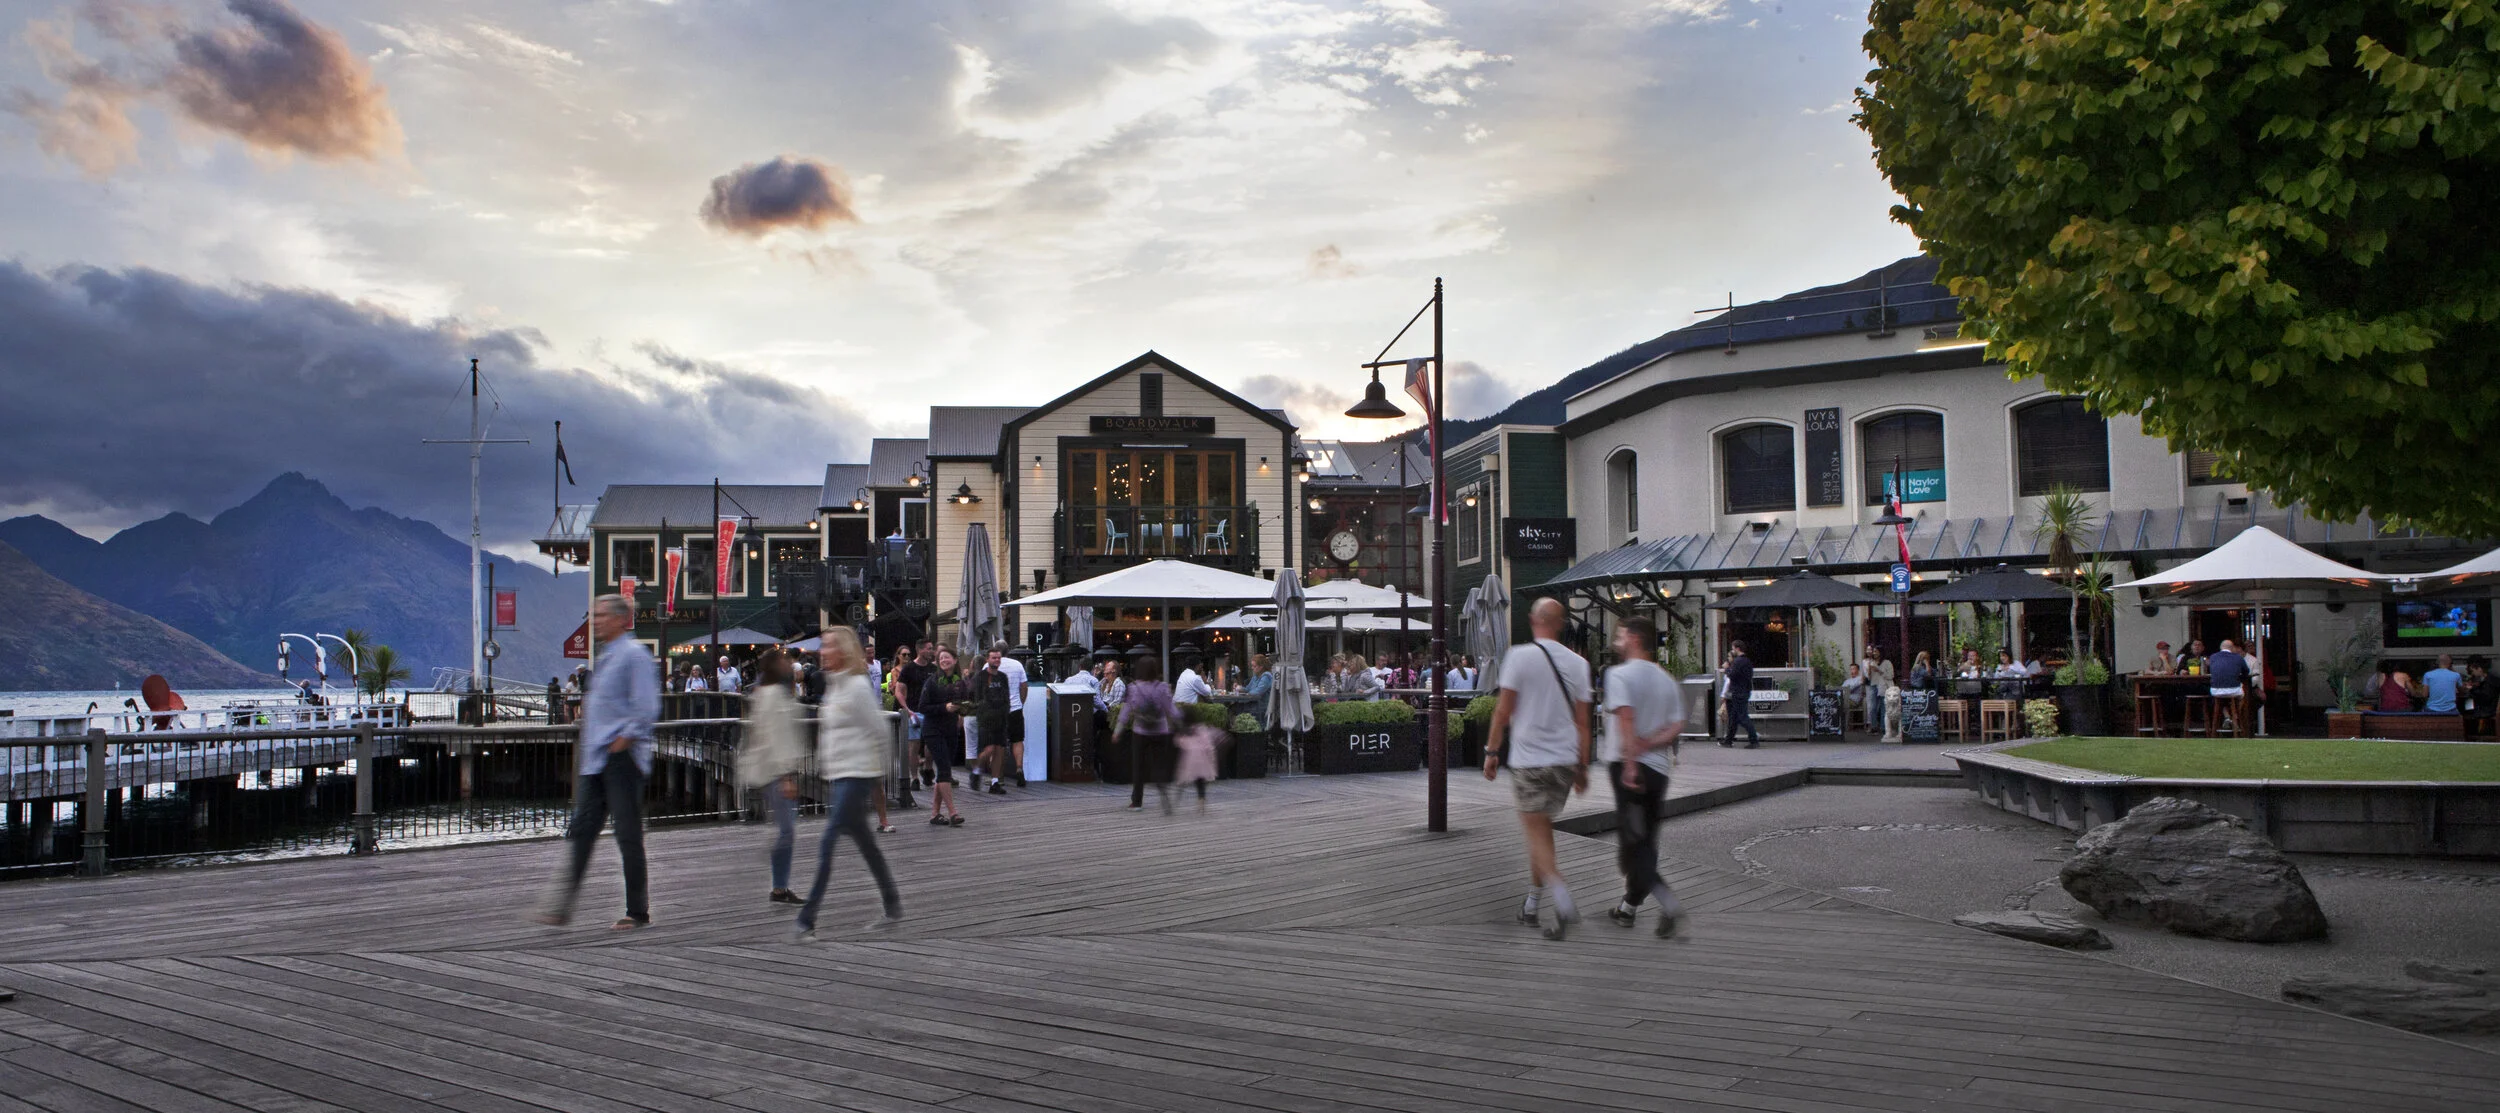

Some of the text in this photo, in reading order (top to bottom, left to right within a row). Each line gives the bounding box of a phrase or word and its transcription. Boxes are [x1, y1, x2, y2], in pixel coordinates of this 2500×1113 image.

[1105, 418, 1200, 428] BOARDWALK
[1808, 410, 1836, 421] IVY &
[1831, 457, 1840, 503] KITCHEN
[1908, 477, 1940, 487] Naylor
[1822, 481, 1831, 502] BAR
[1908, 486, 1931, 495] Love
[905, 599, 926, 608] PIER
[852, 605, 864, 621] B
[1036, 633, 1044, 676] PIER
[1071, 703, 1083, 769] PIER
[1350, 733, 1391, 750] PIER
